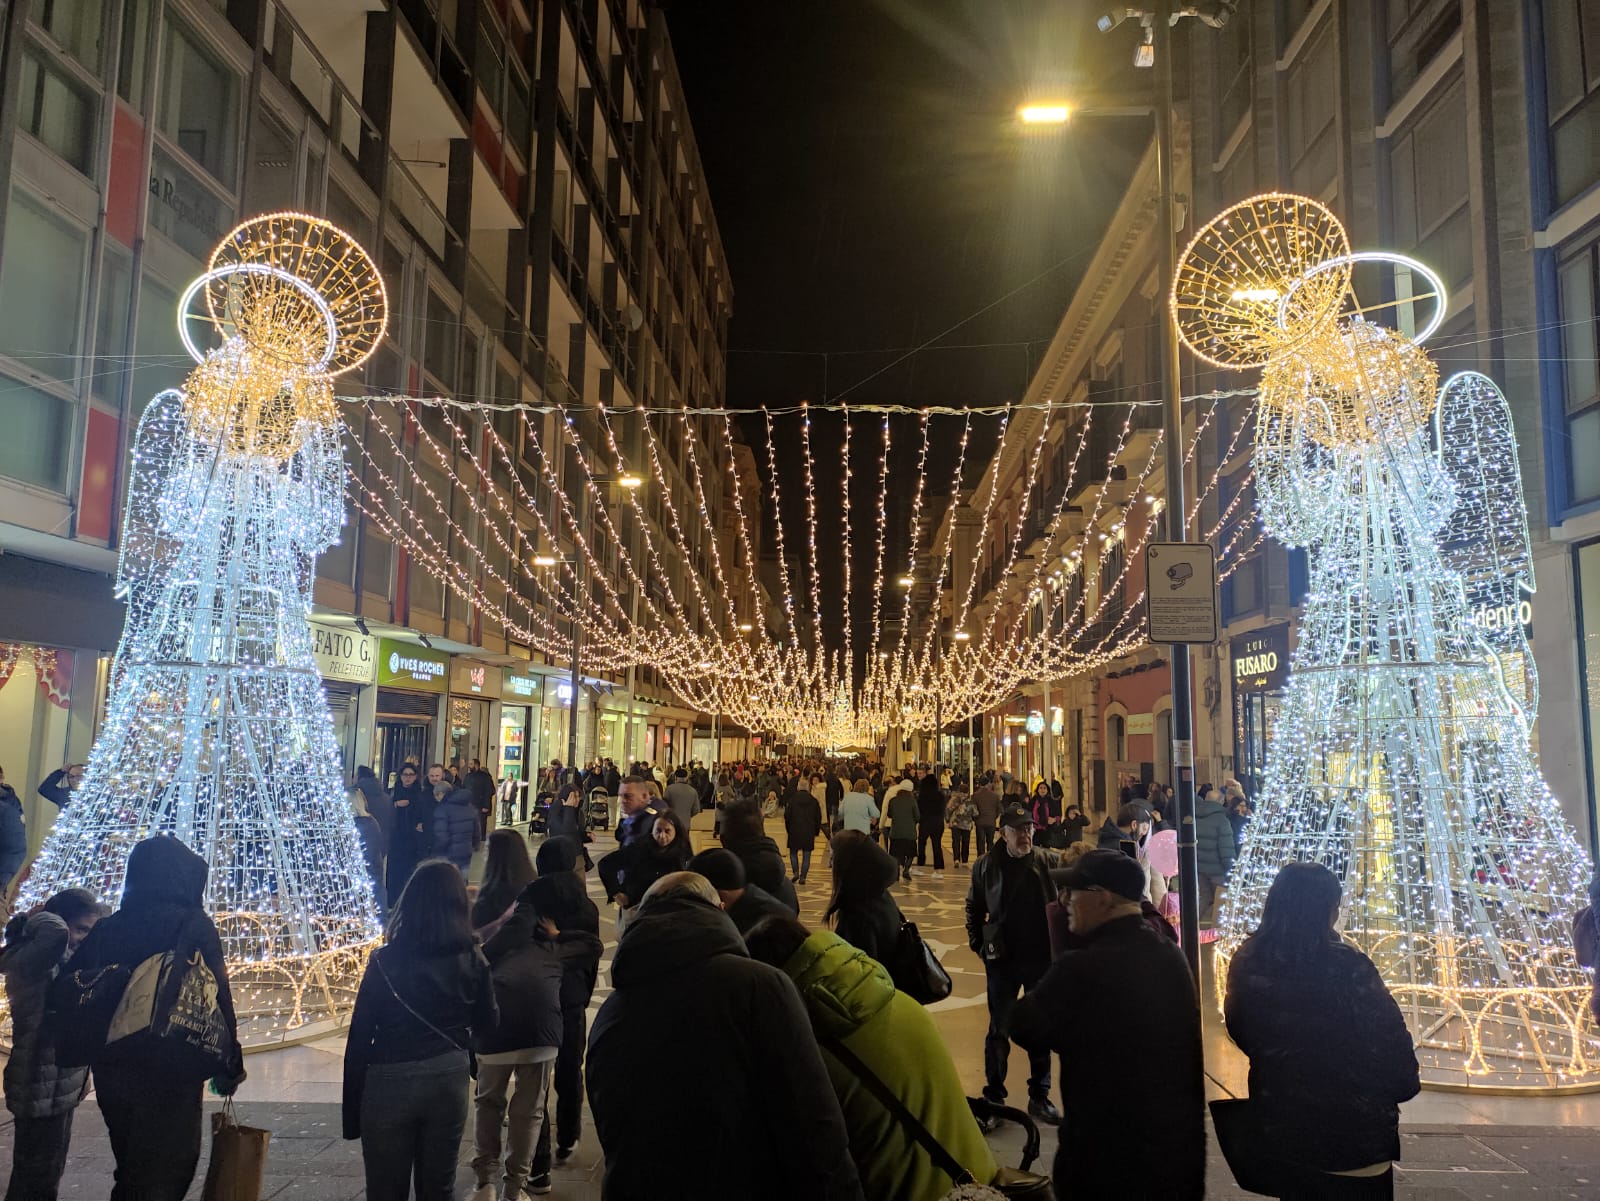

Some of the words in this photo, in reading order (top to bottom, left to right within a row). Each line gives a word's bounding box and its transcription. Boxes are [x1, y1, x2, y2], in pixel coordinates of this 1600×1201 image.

[308, 627, 353, 659] FATO
[360, 639, 371, 662] G.
[400, 657, 418, 672] YVES
[418, 661, 444, 676] ROCHER
[1236, 652, 1278, 677] FUSARO
